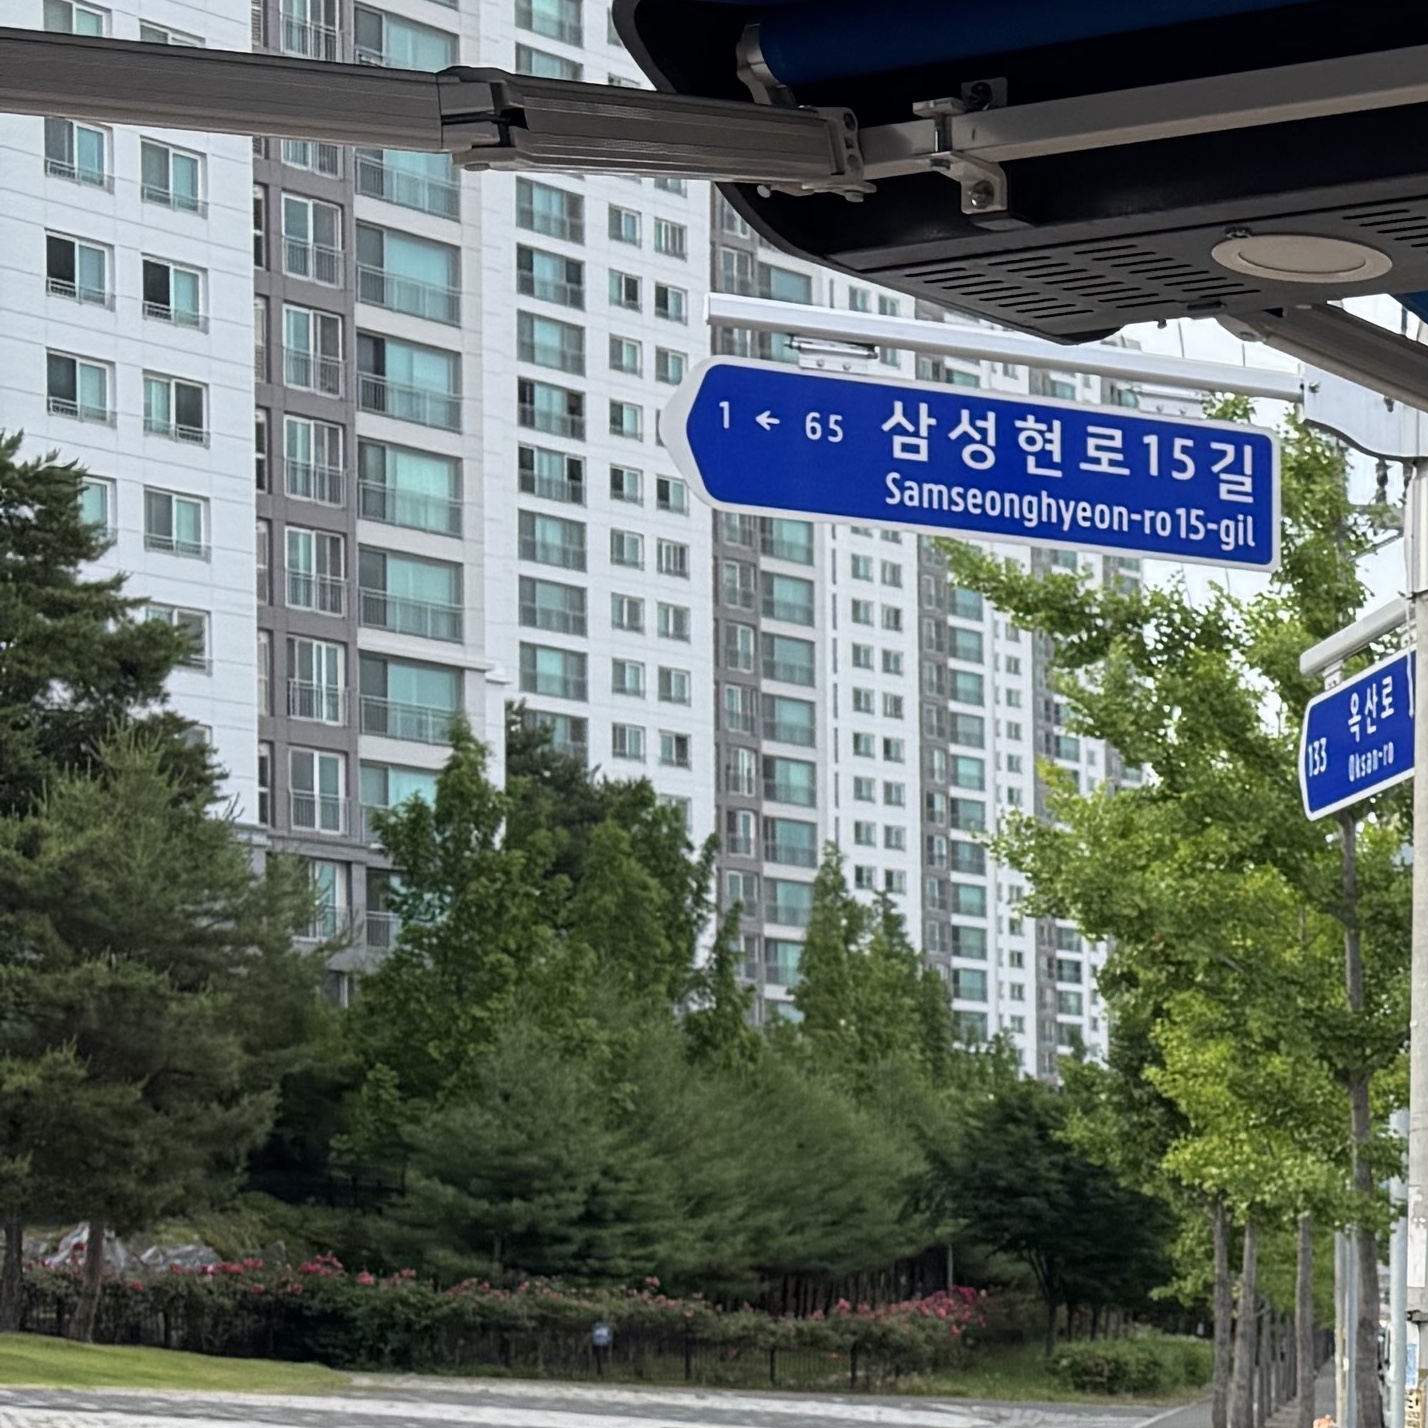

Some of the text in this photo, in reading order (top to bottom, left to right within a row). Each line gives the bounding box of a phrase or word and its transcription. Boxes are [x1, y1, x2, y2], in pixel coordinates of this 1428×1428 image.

[717, 400, 1254, 503] 1 65 삼성현로15길
[1348, 675, 1394, 743] 옥산로
[1308, 737, 1327, 777] 133
[1348, 741, 1394, 782] Oksan-ro
